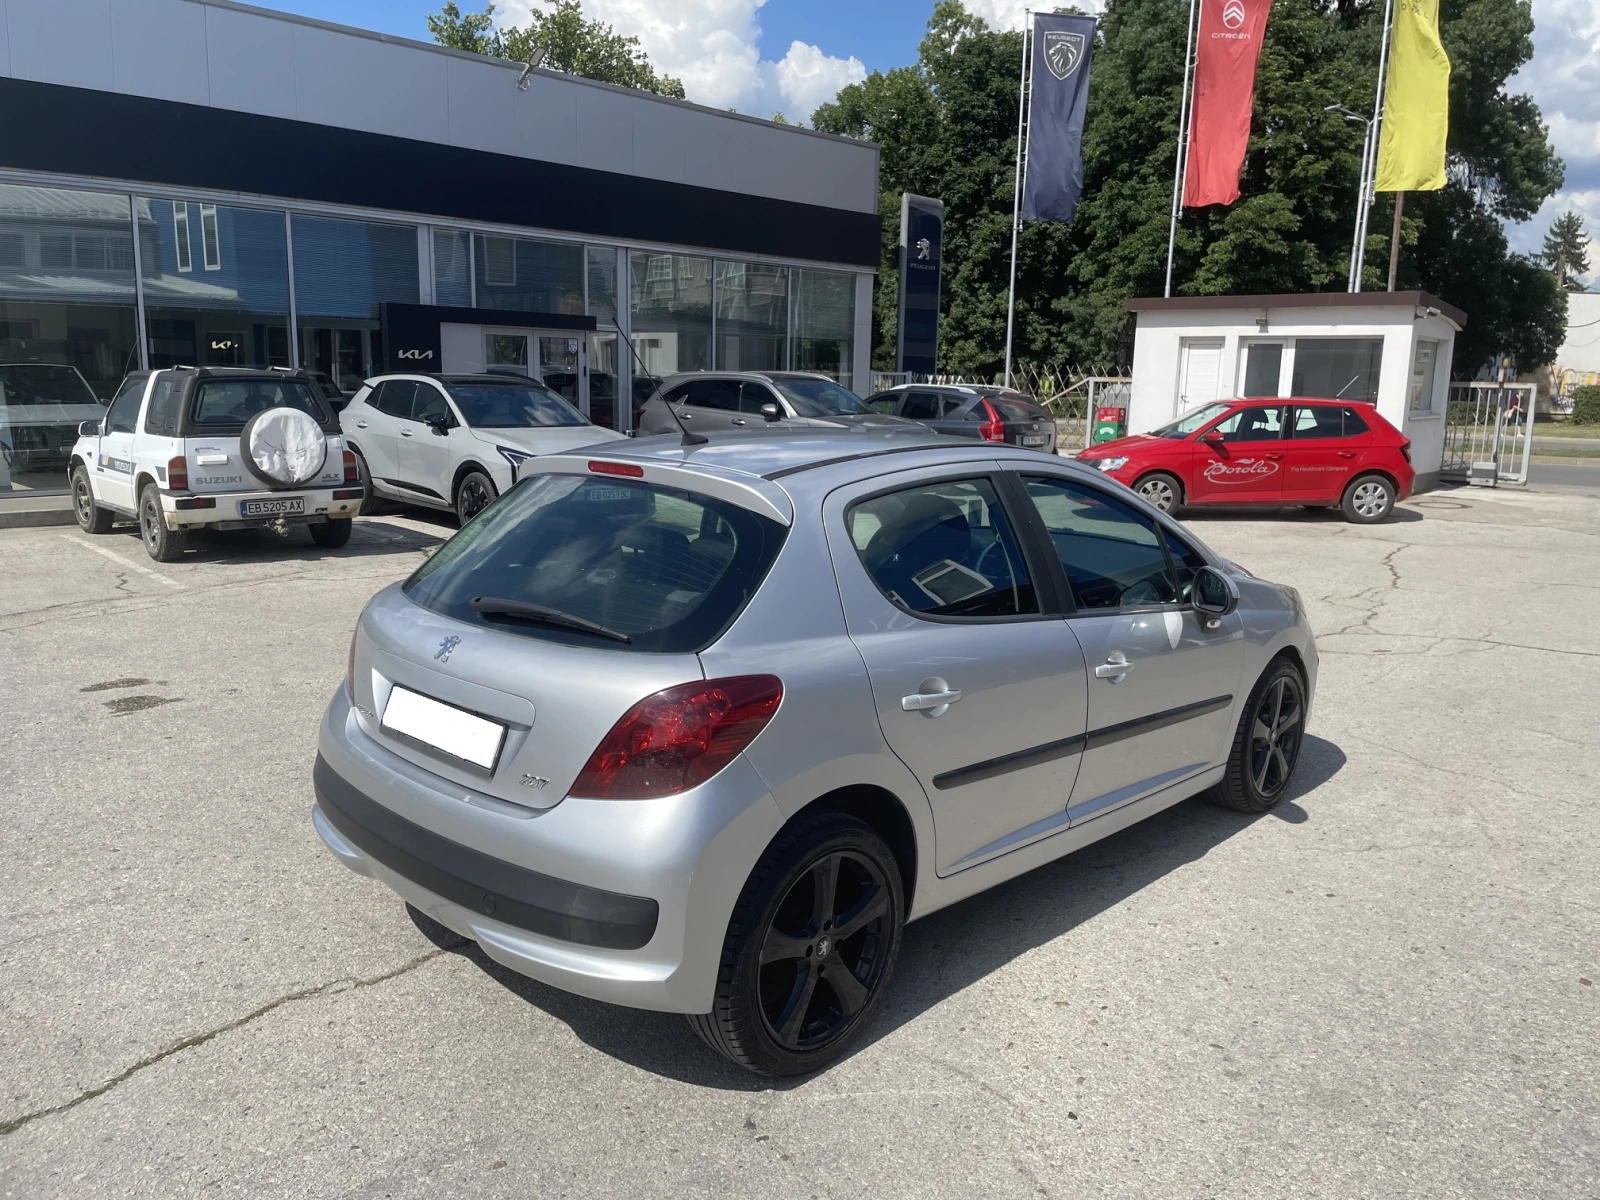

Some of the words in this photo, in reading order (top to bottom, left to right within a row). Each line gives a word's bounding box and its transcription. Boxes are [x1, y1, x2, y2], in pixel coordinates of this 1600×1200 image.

[910, 262, 936, 271] PEUGEOT
[398, 349, 433, 359] KIA
[1203, 459, 1271, 477] Borola
[195, 475, 243, 485] SUZUKI
[248, 503, 262, 514] EB
[263, 501, 288, 513] 5205
[289, 500, 302, 511] AX
[519, 773, 550, 791] 207
